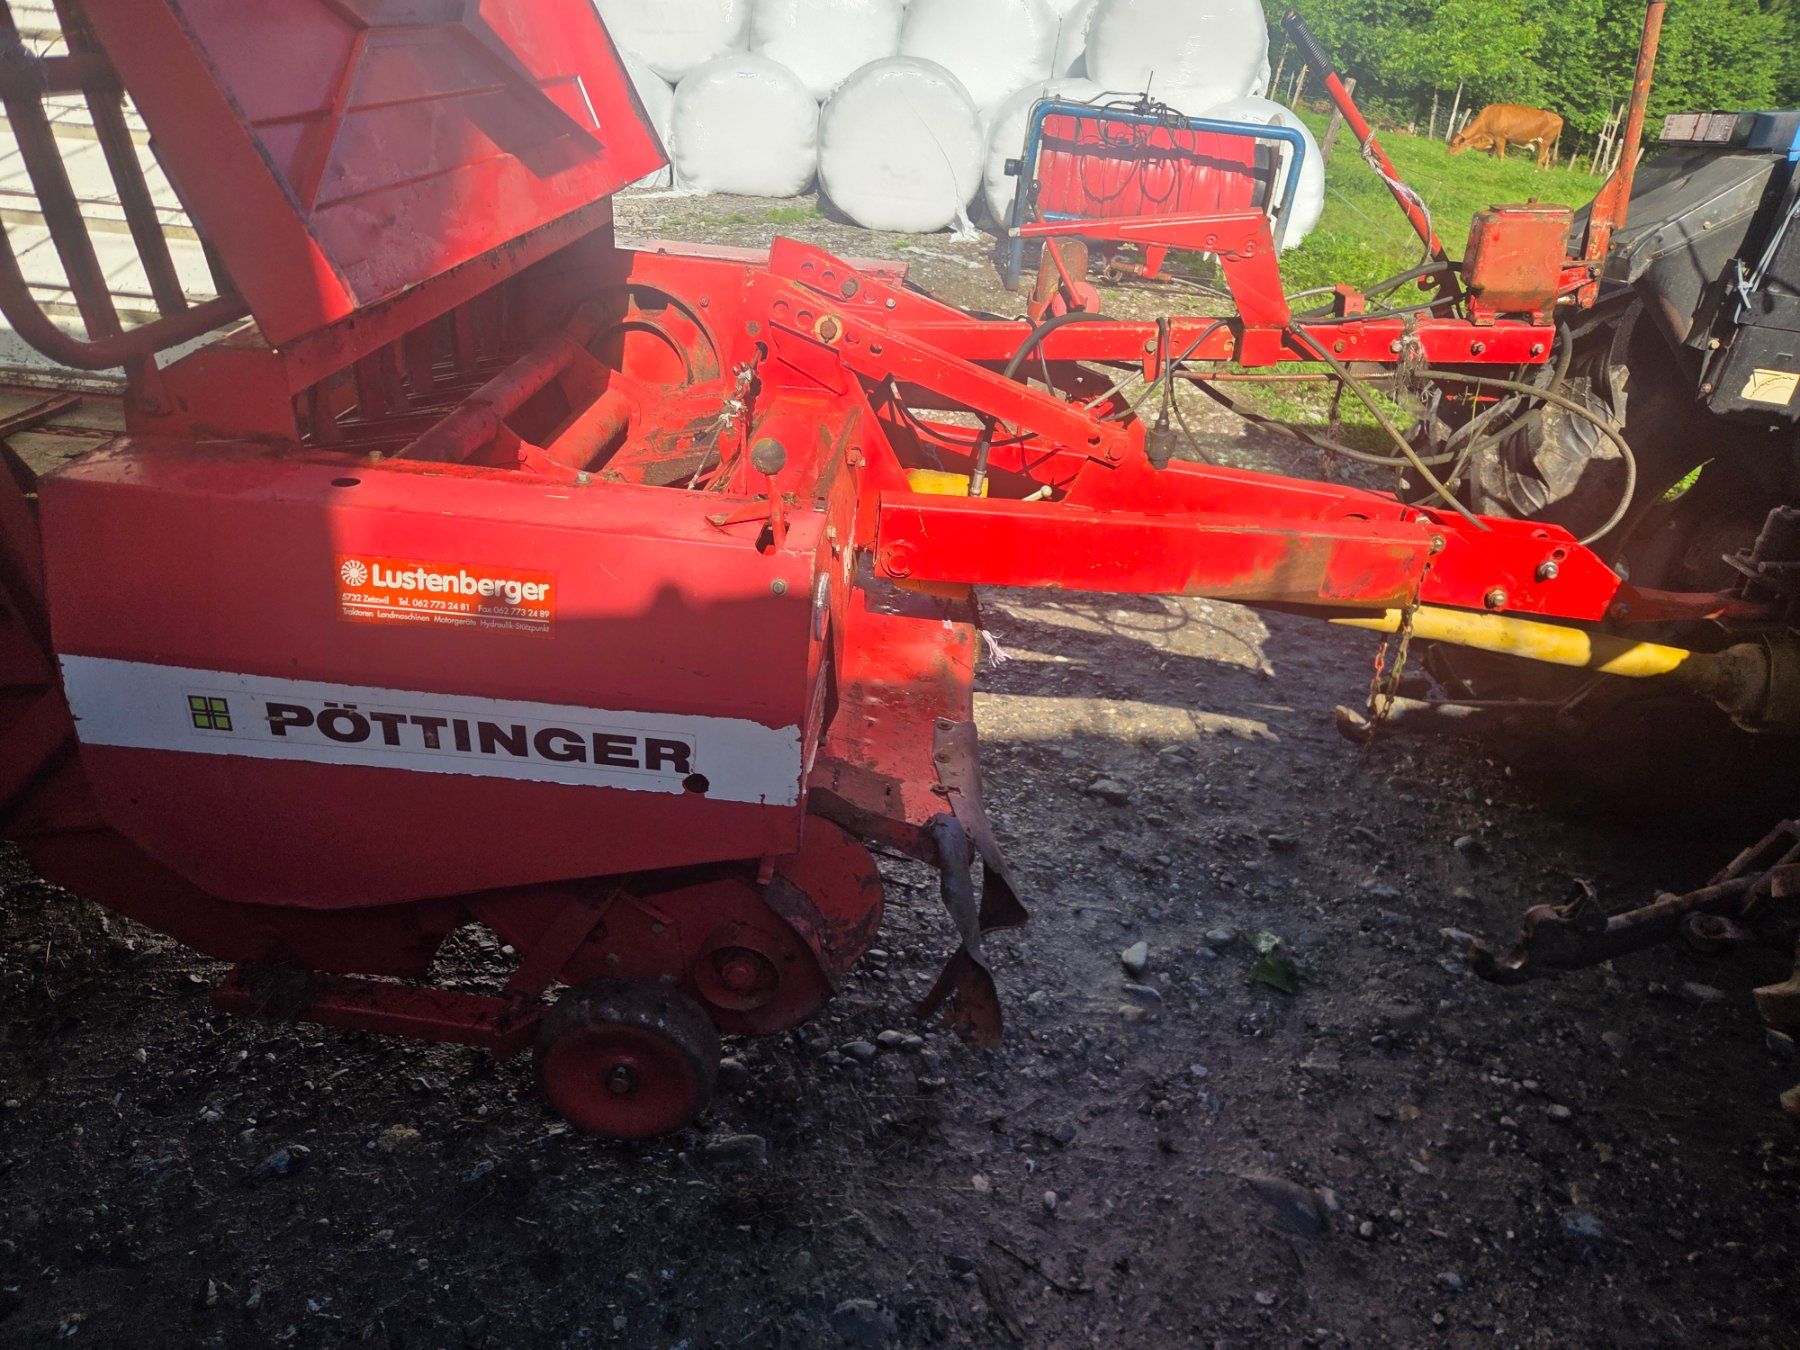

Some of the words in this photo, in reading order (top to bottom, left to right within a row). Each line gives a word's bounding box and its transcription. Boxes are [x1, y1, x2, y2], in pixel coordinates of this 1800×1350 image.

[372, 563, 550, 605] Lustenberger
[342, 593, 361, 602] 5732
[398, 597, 410, 606] Tel.
[412, 599, 428, 608] 062
[430, 600, 446, 609] 773
[448, 602, 458, 610] 24
[460, 603, 470, 611] 81
[478, 604, 491, 613] Fax
[493, 606, 508, 615] 062
[510, 607, 526, 616] 773
[528, 609, 537, 617] 24
[539, 610, 550, 618] 89
[342, 607, 374, 617] Traktoren
[377, 610, 430, 622] Landmaschinen
[265, 701, 692, 774] PÖTTINGER
